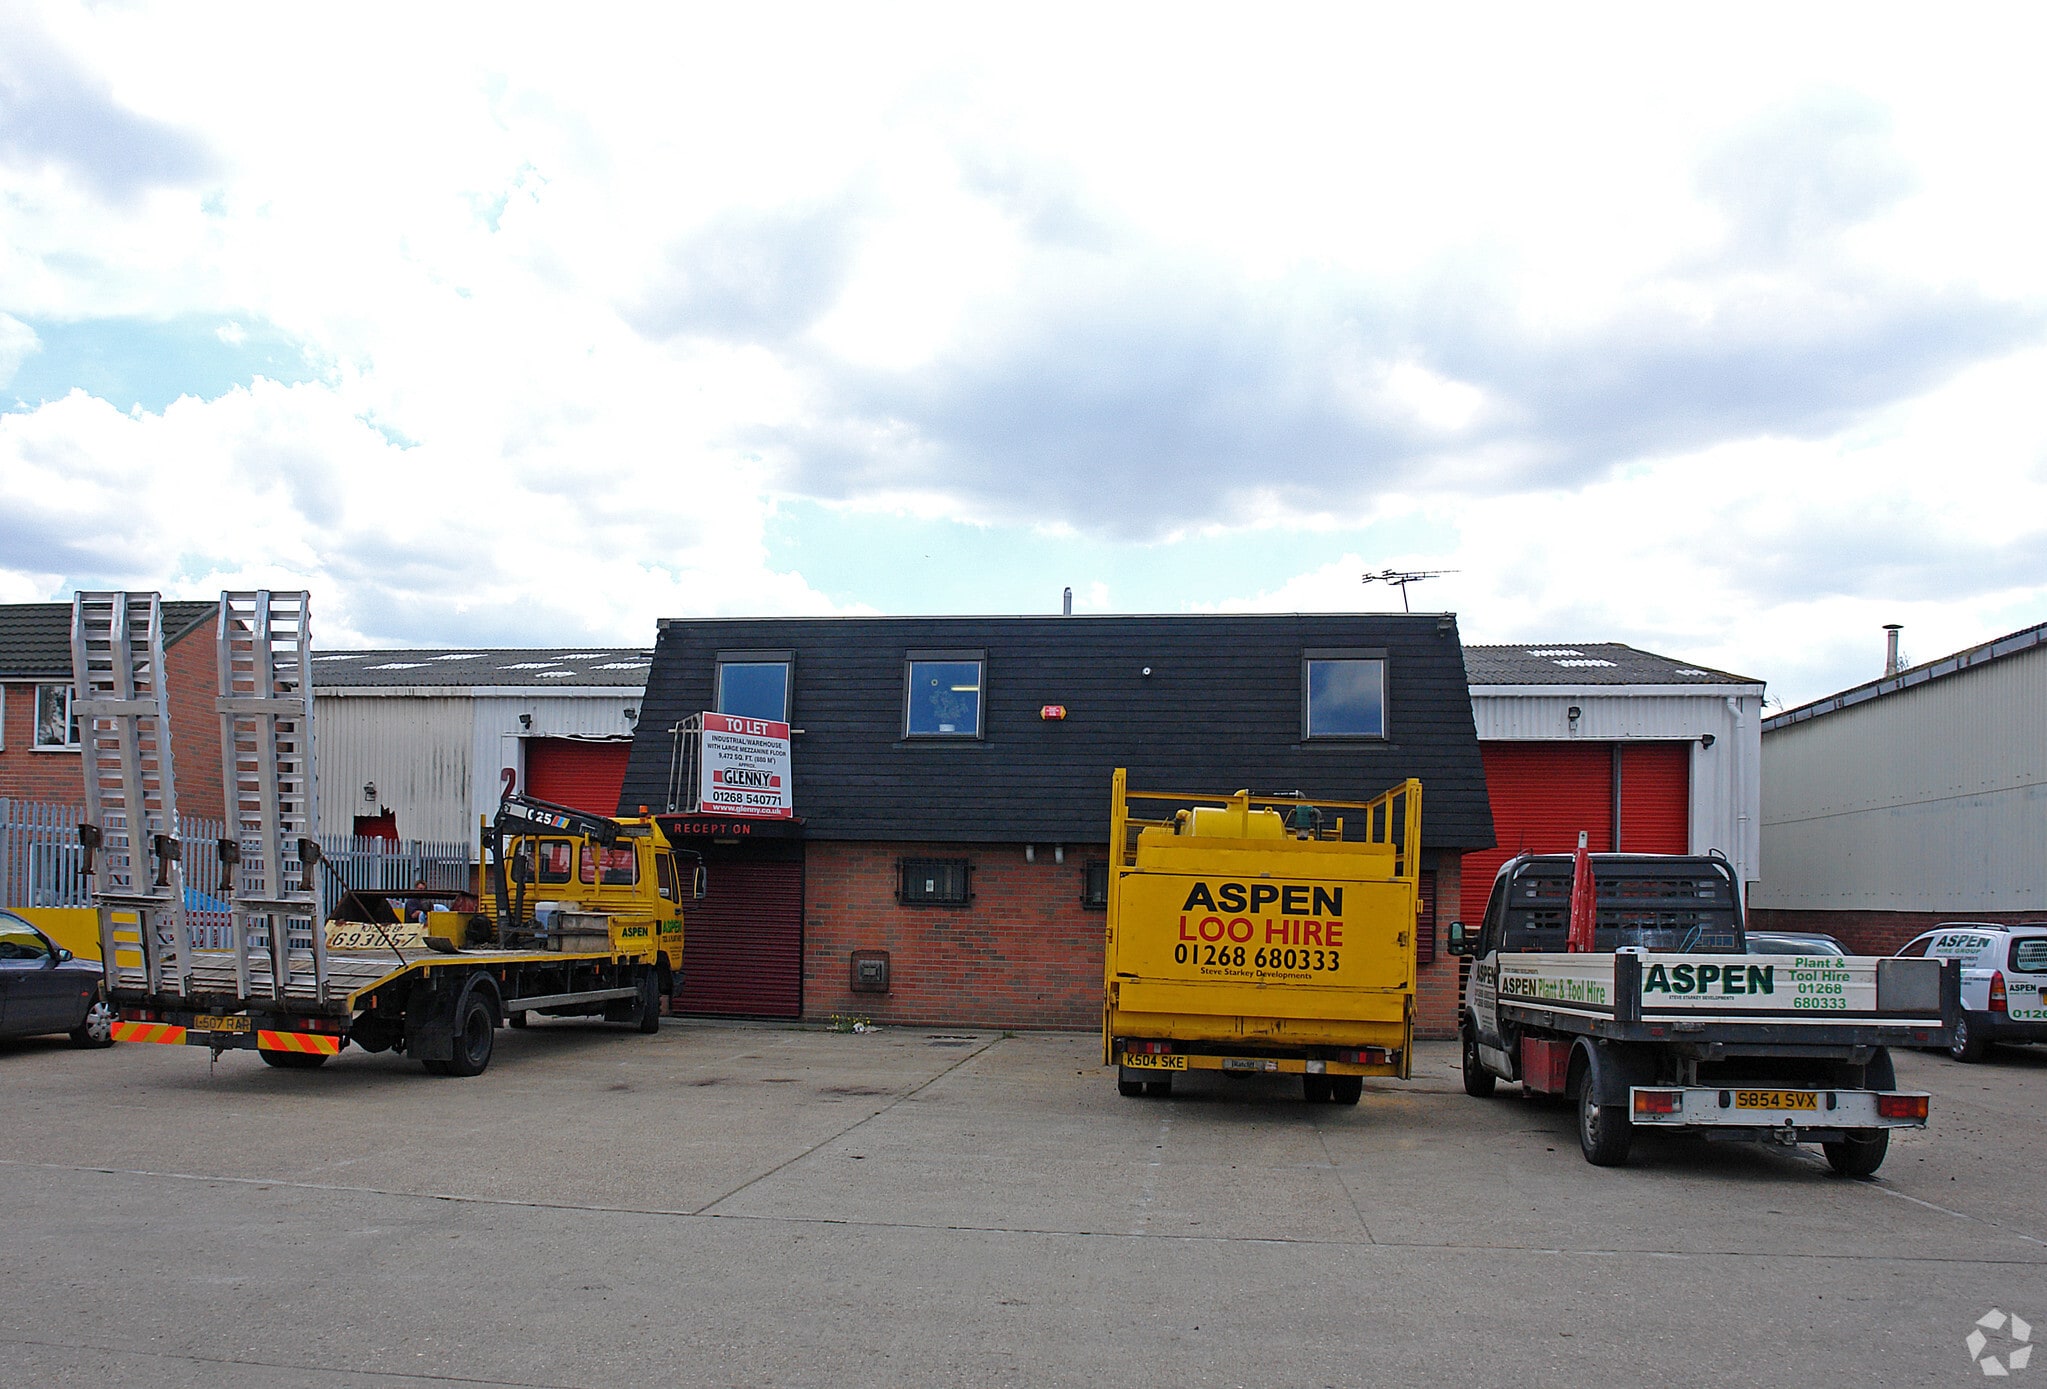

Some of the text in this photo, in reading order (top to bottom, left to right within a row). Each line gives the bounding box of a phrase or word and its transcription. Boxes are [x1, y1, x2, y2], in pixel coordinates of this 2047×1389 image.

[726, 718, 768, 735] TO LET
[711, 735, 782, 749] INDUSTRIAL/WAREHOUSE
[721, 744, 739, 753] LARGE
[739, 746, 769, 756] MEZZANINE
[769, 749, 787, 757] FLOOR
[724, 769, 772, 788] GLENNY
[713, 791, 782, 806] 01268 540771
[712, 804, 782, 815] www.glenny.co.uk
[535, 811, 553, 825] 25
[1181, 882, 1344, 917] ASPEN
[622, 926, 649, 938] ASPEN
[1179, 915, 1344, 947] LOO HIRE
[1936, 934, 1991, 948] ASPEN
[1174, 943, 1340, 972] 01268 680333
[1795, 957, 1846, 969] Plant &
[1200, 967, 1312, 980] Steve Starkey Developments
[1643, 963, 1775, 995] ASPEN
[1788, 970, 1850, 982] Tool Hire
[1502, 977, 1606, 1004] ASPEN Plant & Tool Hire
[1798, 983, 1843, 995] 01268
[2009, 984, 2037, 992] ASPEN
[1793, 997, 1847, 1009] 680333
[1127, 1054, 1185, 1069] K504 SKE
[1738, 1092, 1816, 1108] S854 SVX
